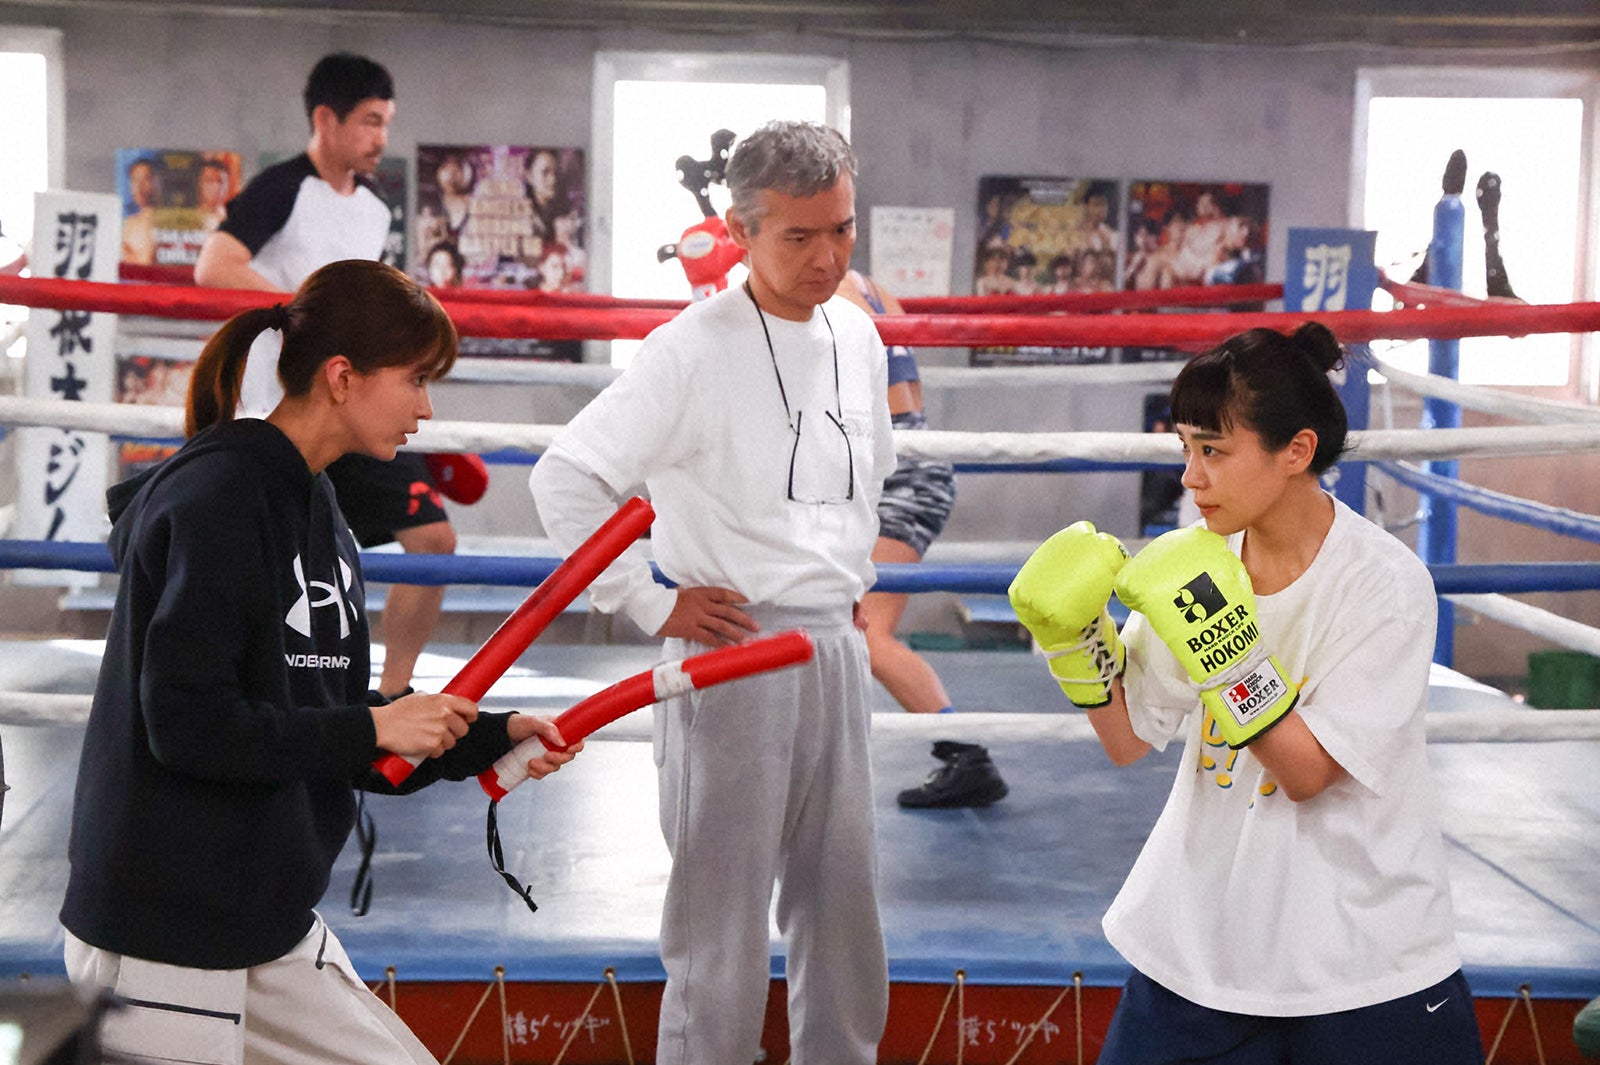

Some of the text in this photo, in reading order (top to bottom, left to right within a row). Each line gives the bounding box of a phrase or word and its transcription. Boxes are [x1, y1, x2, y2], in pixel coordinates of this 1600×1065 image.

[1186, 604, 1249, 654] BOXER
[1204, 622, 1245, 652] HARD KNOCK LIFE
[1200, 621, 1259, 673] HOKOMI
[1243, 672, 1258, 685] HARD
[1247, 674, 1264, 689] KNOCK
[1249, 684, 1261, 694] LIFE
[1237, 679, 1280, 715] BOXER
